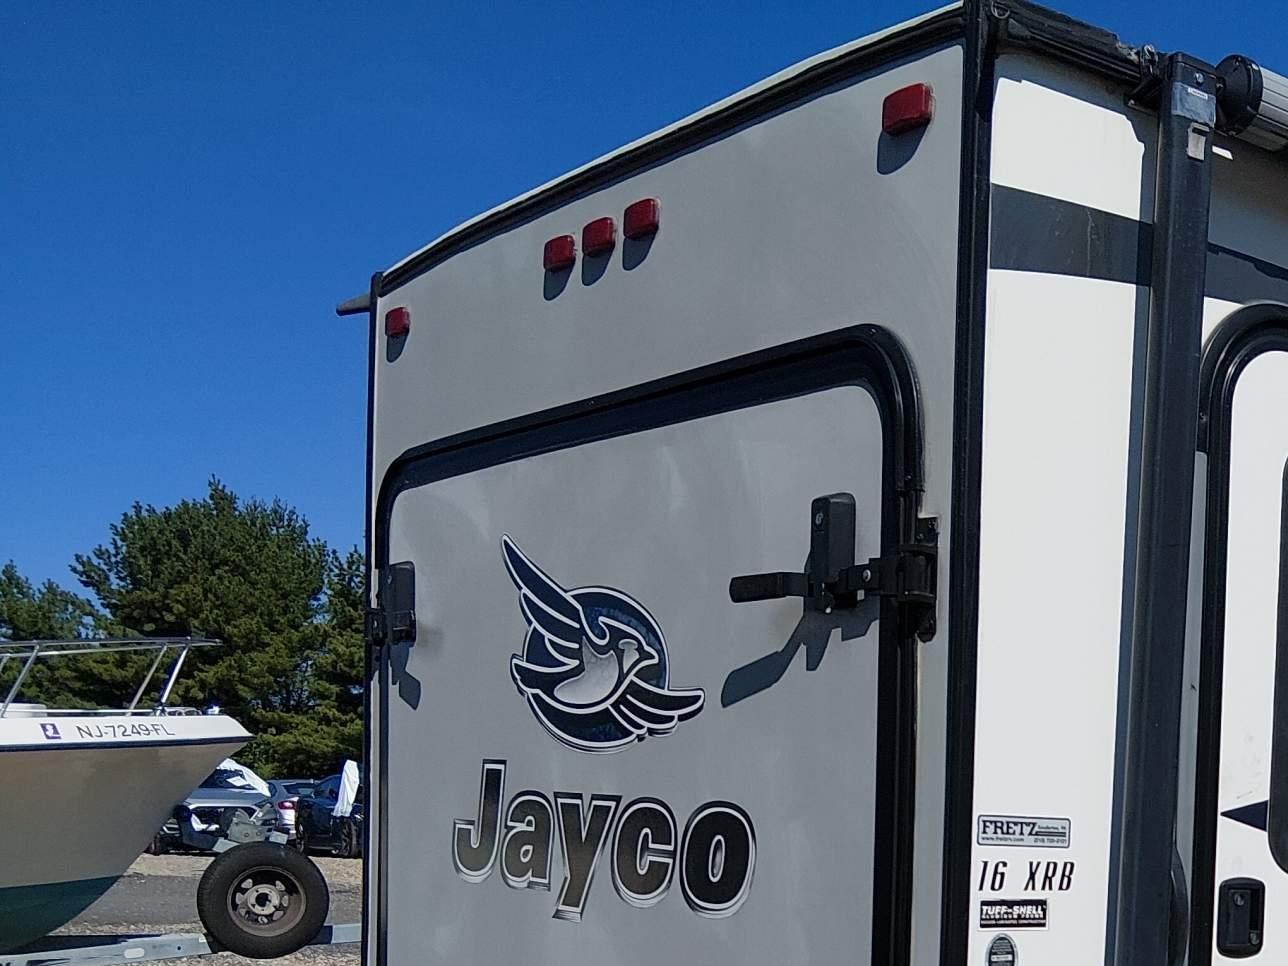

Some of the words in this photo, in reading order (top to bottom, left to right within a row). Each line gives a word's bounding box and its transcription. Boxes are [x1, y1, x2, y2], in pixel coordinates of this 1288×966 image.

[452, 758, 758, 923] Jayco
[981, 820, 1039, 836] FRETZ
[978, 860, 1008, 891] 16
[1024, 860, 1075, 891] XRB
